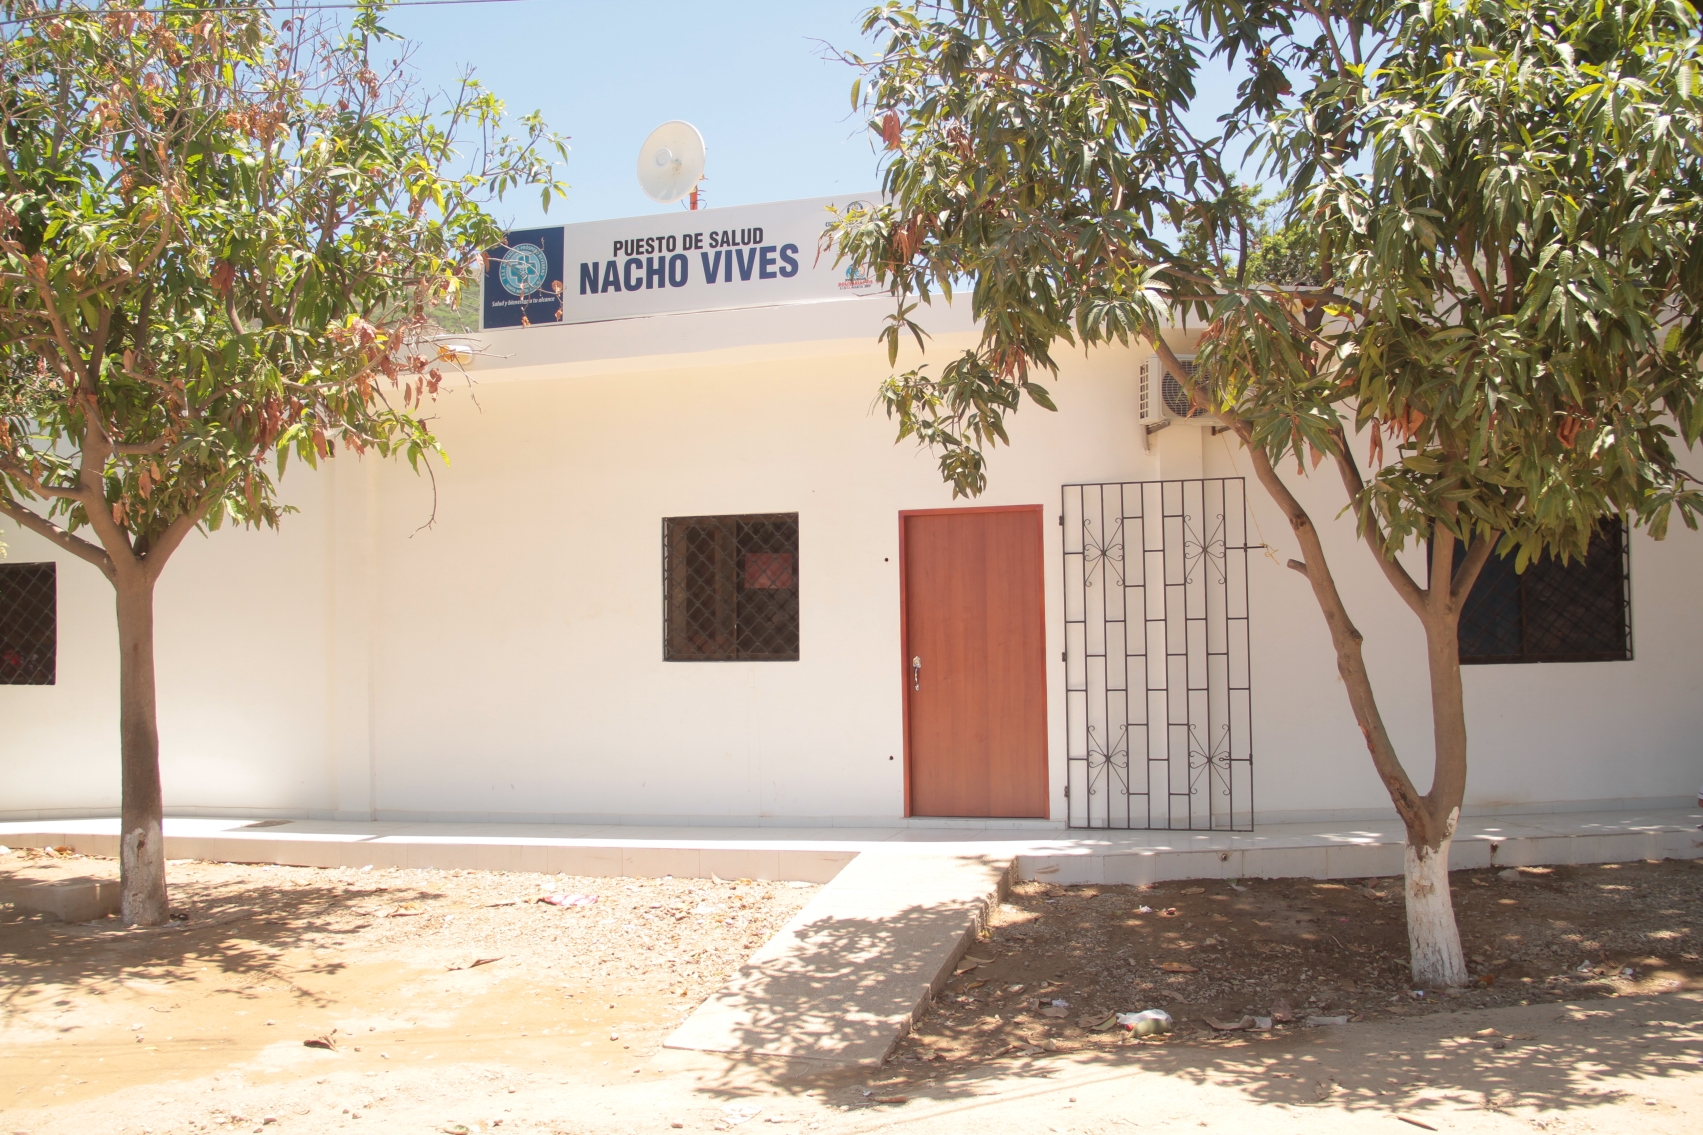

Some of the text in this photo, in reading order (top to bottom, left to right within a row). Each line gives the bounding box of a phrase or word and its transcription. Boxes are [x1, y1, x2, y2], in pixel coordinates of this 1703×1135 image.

[613, 227, 764, 257] PUESTO DE SALUD
[580, 243, 799, 295] NACHO VIVES
